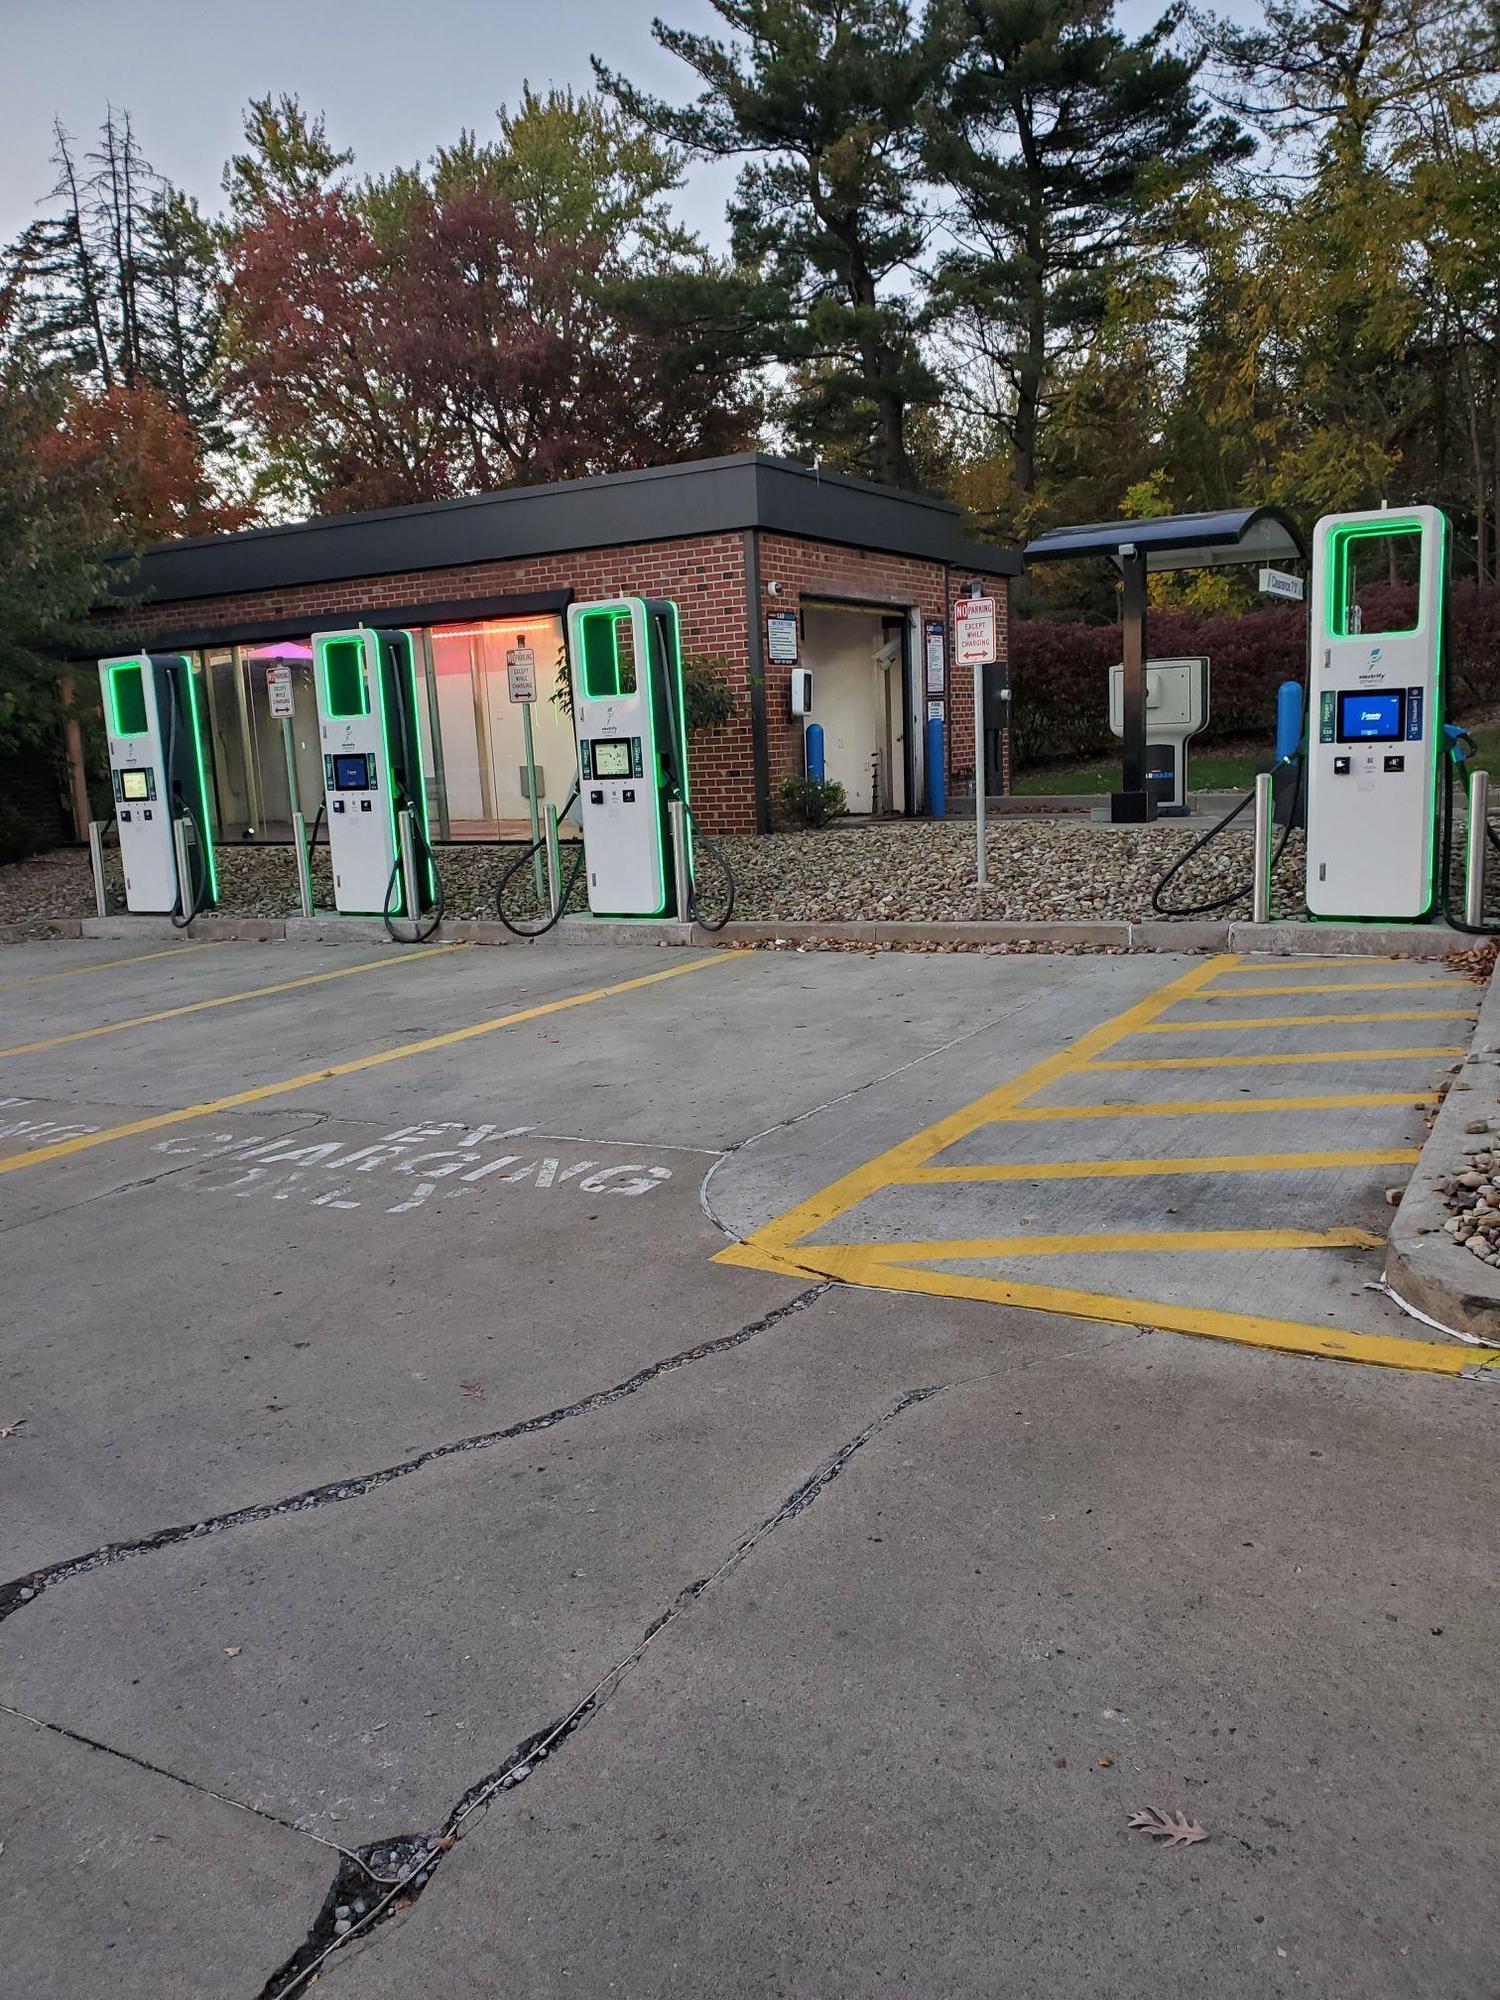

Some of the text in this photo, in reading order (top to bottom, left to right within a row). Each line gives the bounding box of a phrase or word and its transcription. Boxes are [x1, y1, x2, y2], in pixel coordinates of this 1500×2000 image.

[957, 604, 992, 618] NO PARKING
[964, 622, 985, 631] EXCEPT
[961, 639, 990, 648] CHARGING
[378, 1120, 538, 1148] EV
[149, 1133, 674, 1196] CHARGING
